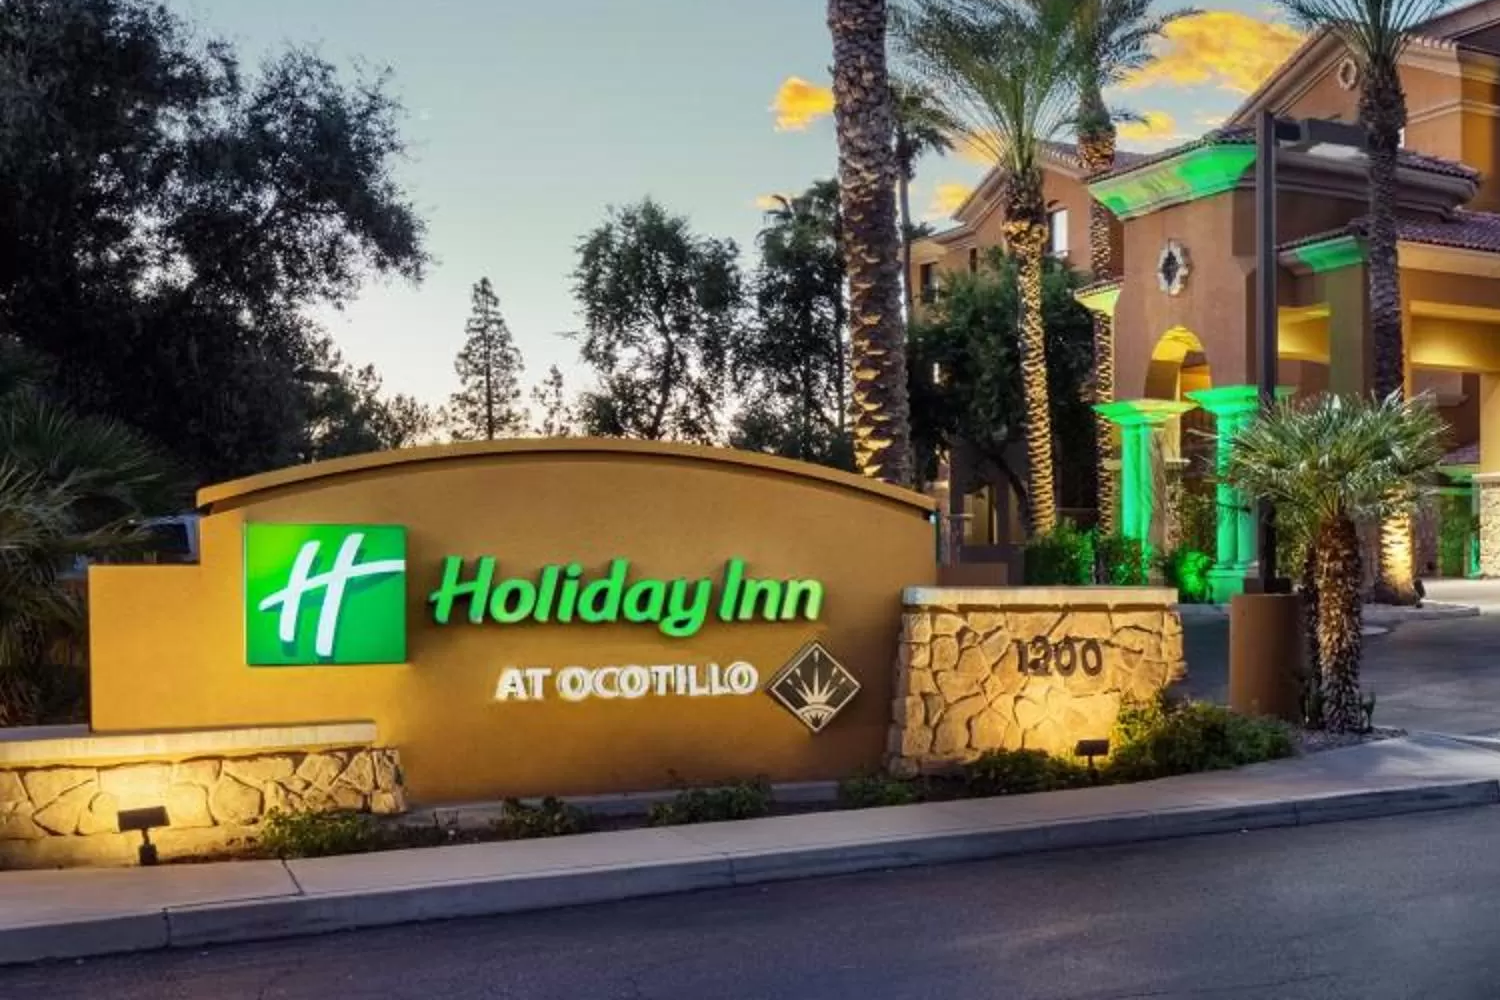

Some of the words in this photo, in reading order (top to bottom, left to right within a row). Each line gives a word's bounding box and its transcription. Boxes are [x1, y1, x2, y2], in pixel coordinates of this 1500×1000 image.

[428, 555, 713, 638] Holiday
[719, 555, 825, 622] Inn
[1011, 635, 1103, 677] 1200
[495, 666, 552, 702] AT
[556, 660, 760, 702] OCOTILLO
